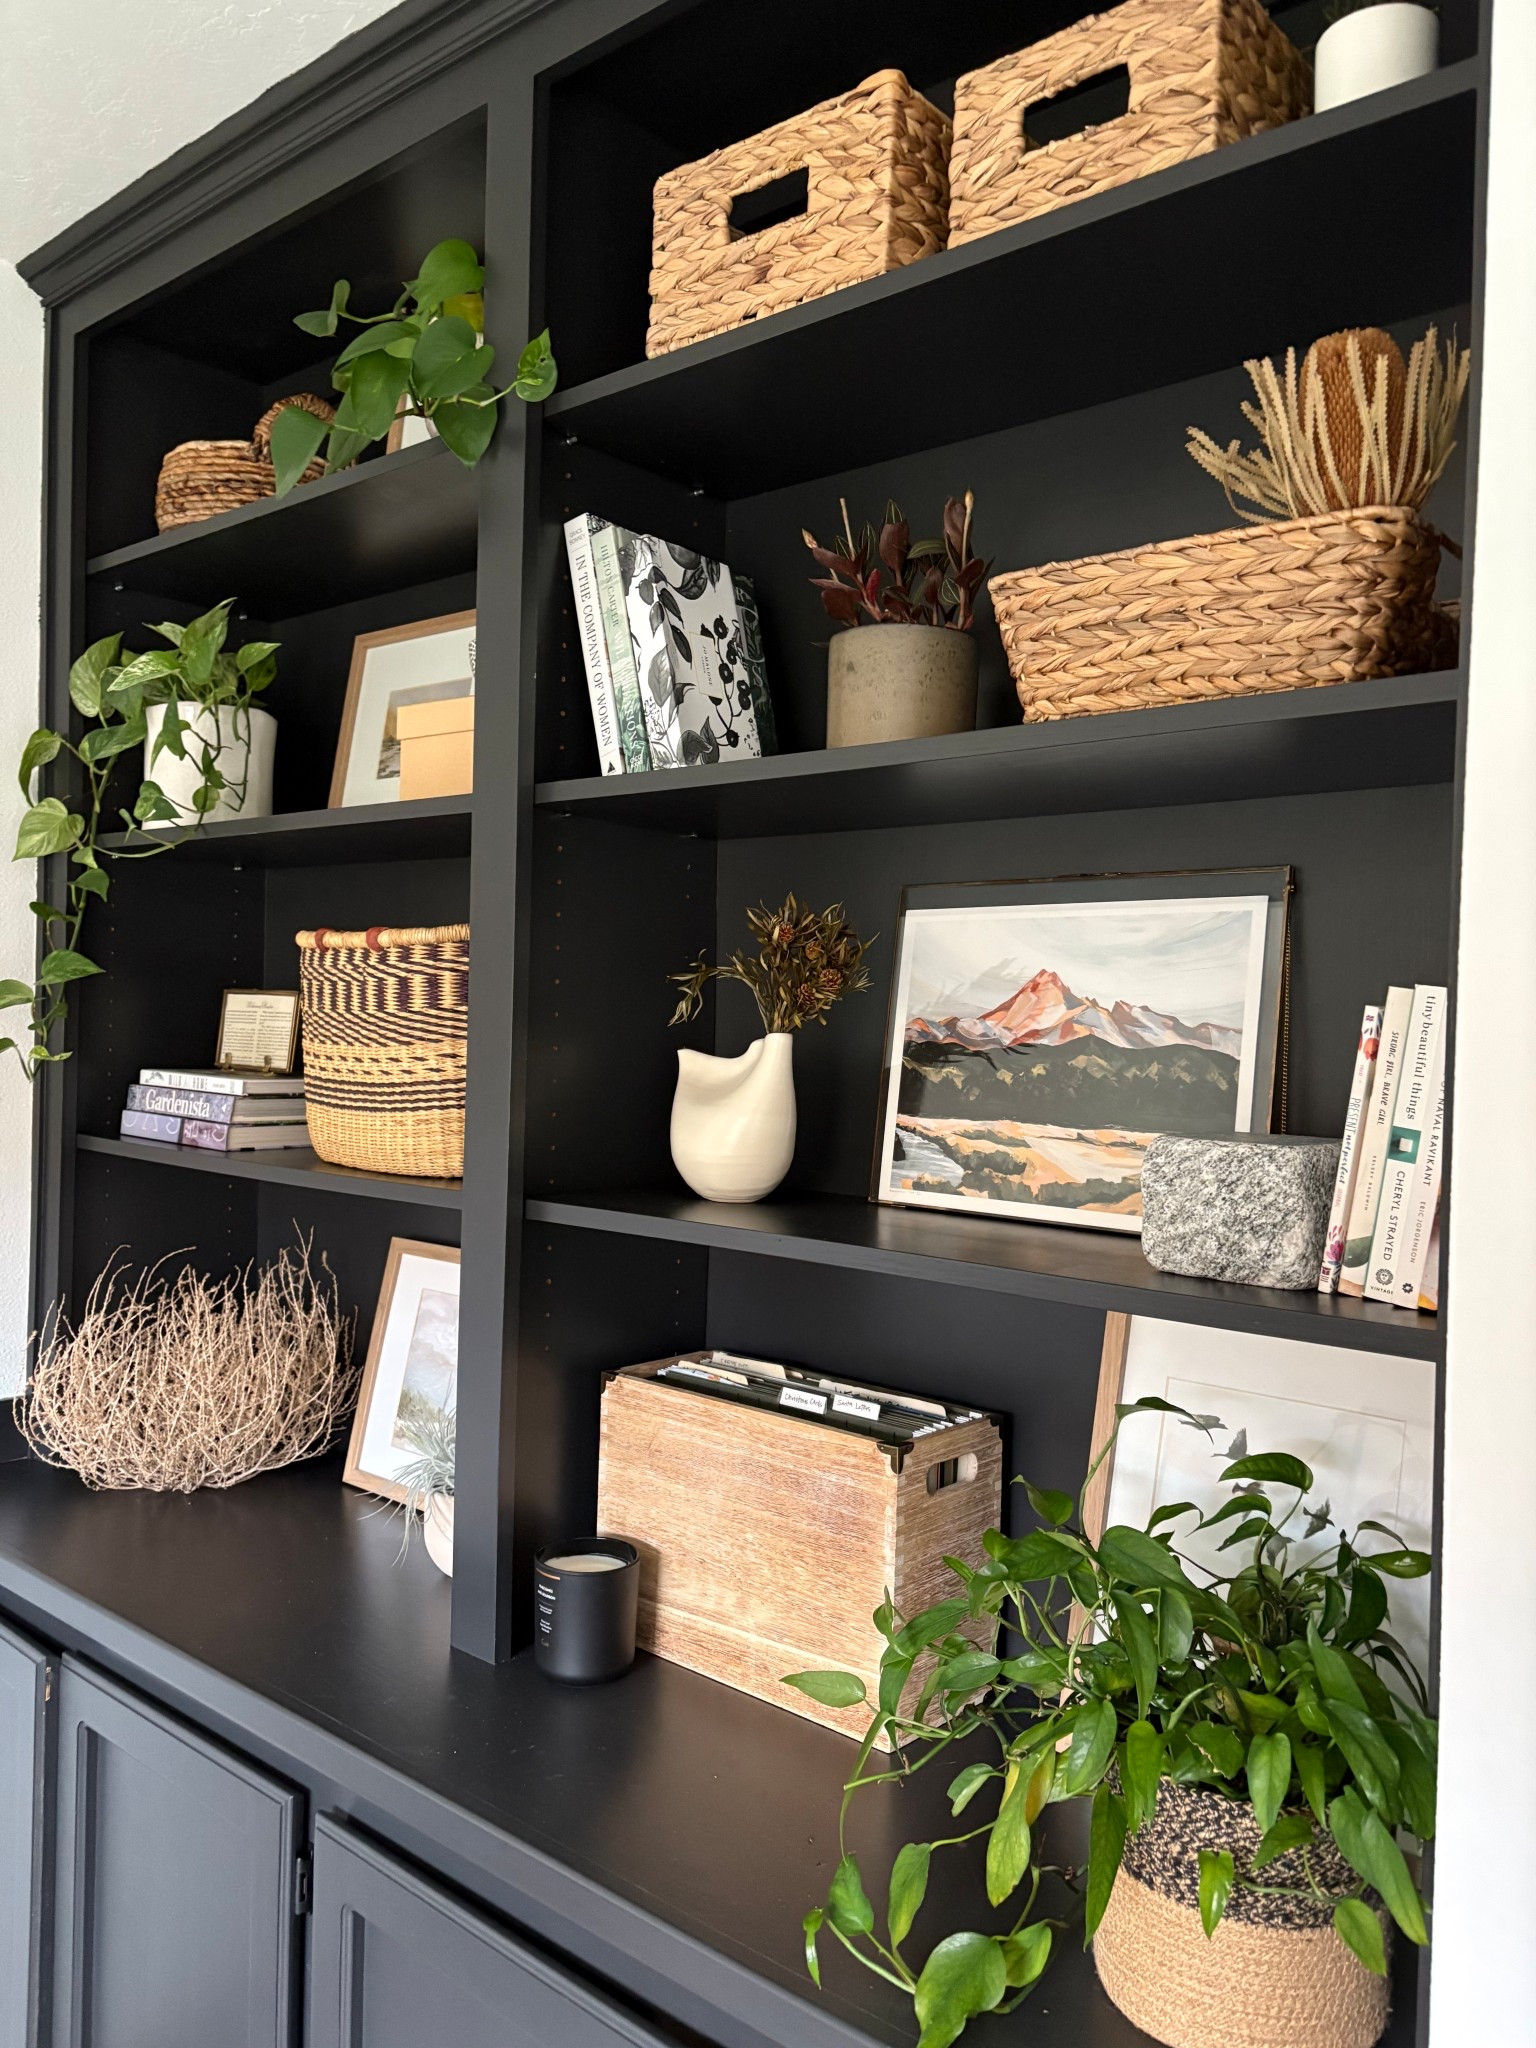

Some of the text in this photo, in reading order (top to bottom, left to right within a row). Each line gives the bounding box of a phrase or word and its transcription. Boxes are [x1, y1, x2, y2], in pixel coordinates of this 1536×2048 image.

[601, 545, 613, 584] HILTON
[608, 586, 620, 626] CARTER
[576, 554, 612, 747] IN THE COMPANY OF WOMEN
[1406, 996, 1436, 1120] tiny beautiful things
[146, 1089, 210, 1118] Gardenista
[1345, 1098, 1361, 1135] PRESENT
[1433, 1097, 1444, 1131] NAVAL
[1339, 1151, 1349, 1184] perfect
[1364, 1155, 1377, 1211] KELSEY BALDWIN
[1423, 1134, 1440, 1187] RAVIKANT
[1383, 1171, 1406, 1261] CHERYL STRAYED
